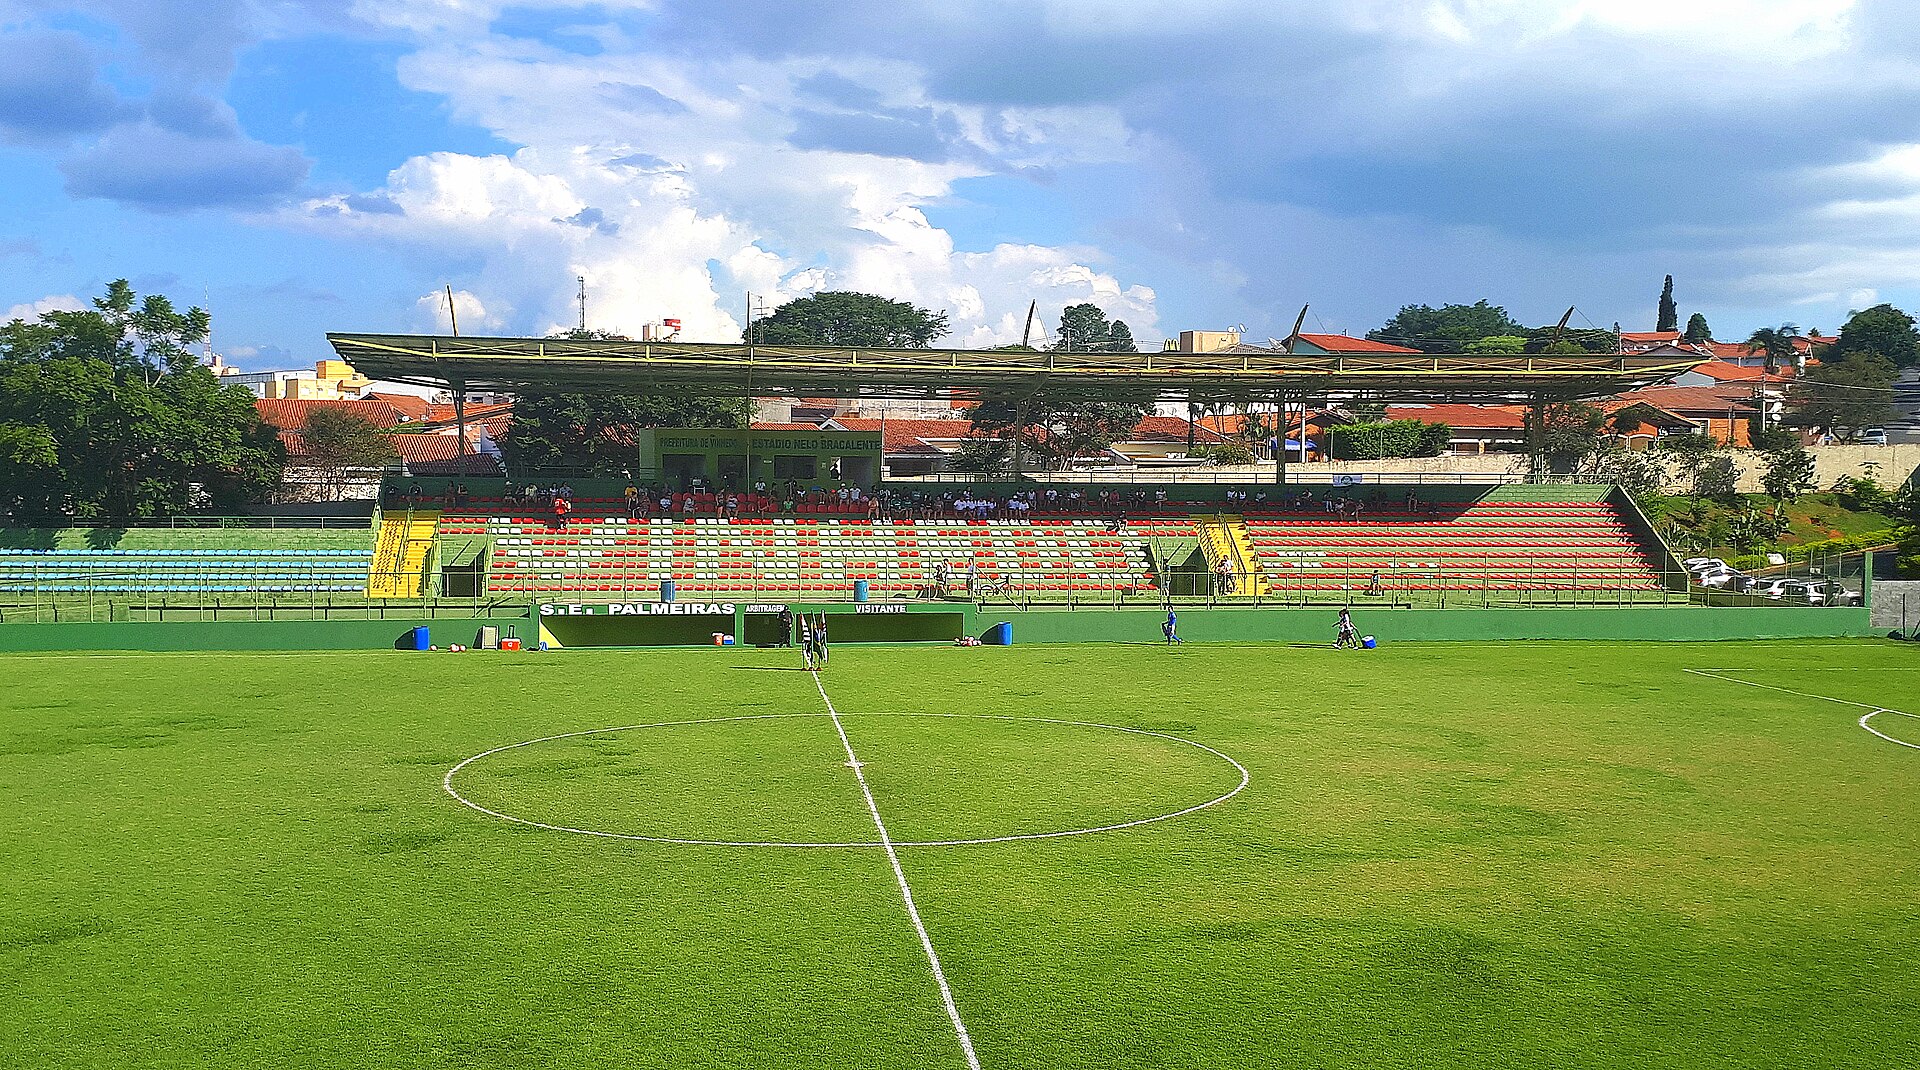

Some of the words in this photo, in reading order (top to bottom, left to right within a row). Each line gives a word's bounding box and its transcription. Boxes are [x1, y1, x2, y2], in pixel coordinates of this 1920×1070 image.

[660, 437, 698, 448] PREFEITURA
[701, 438, 709, 448] DE
[794, 439, 818, 450] NELO
[540, 603, 595, 615] S.E.
[608, 603, 736, 616] PALMEIRAS
[855, 604, 907, 614] VISITANTE
